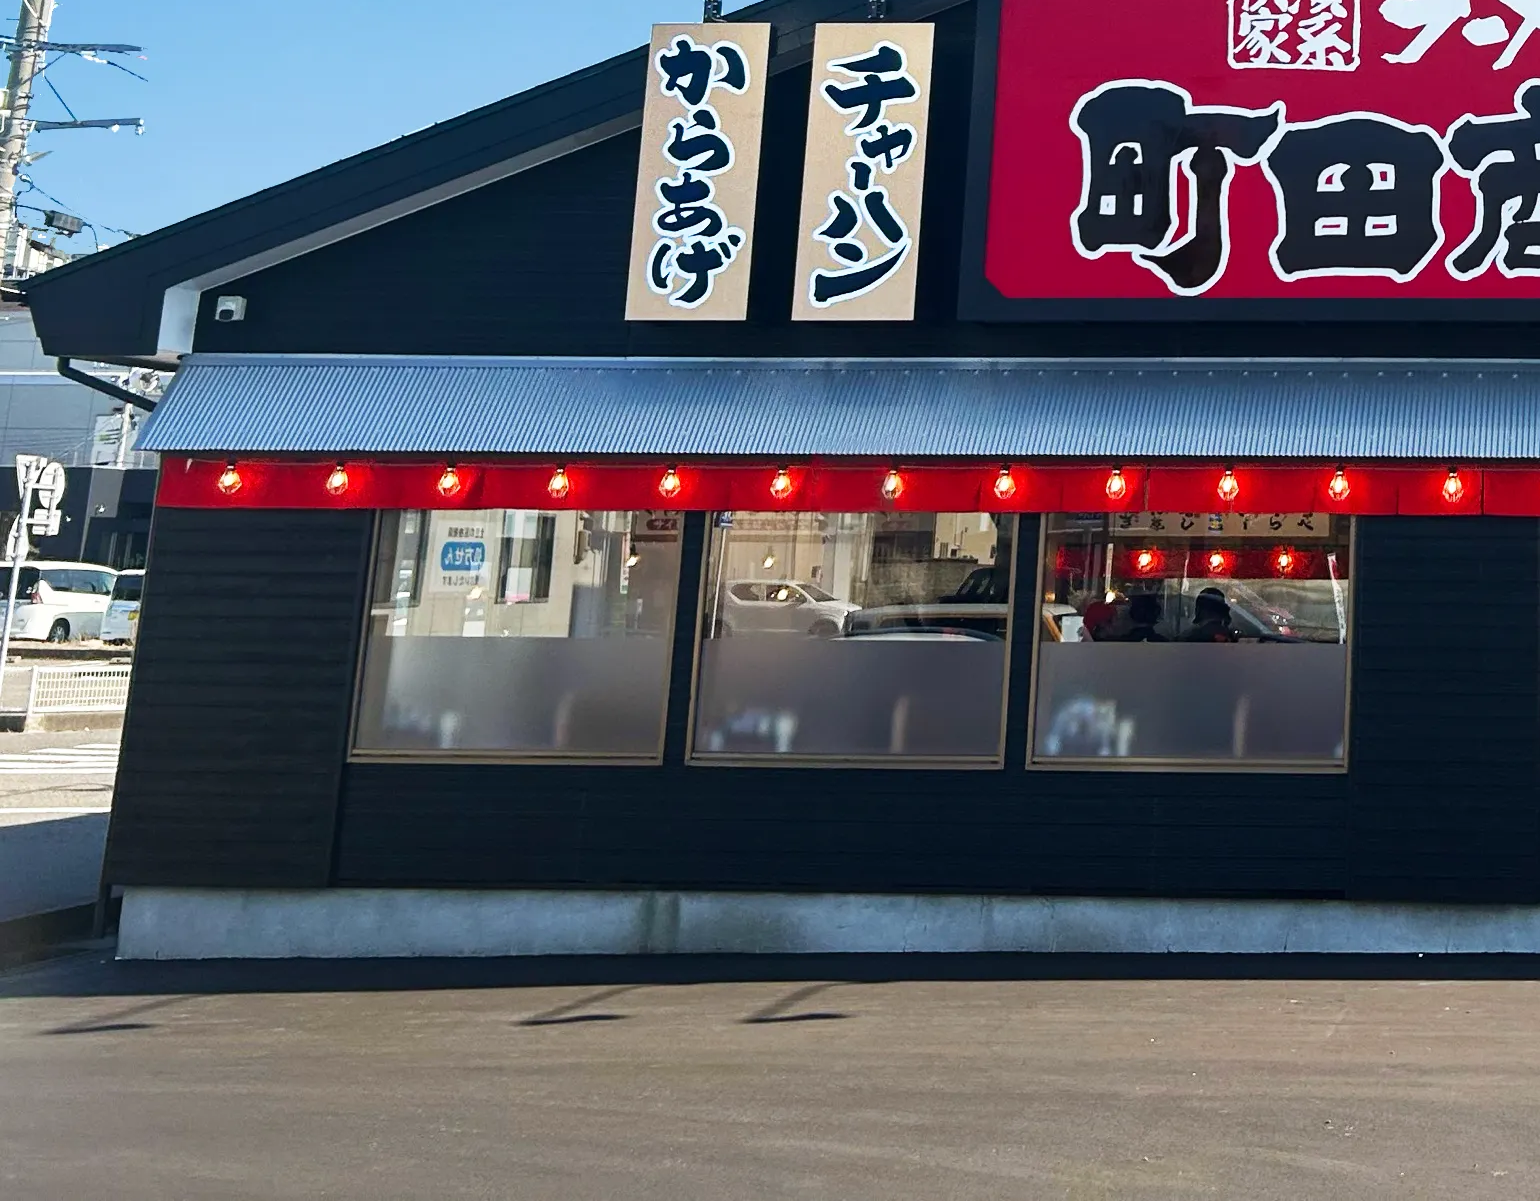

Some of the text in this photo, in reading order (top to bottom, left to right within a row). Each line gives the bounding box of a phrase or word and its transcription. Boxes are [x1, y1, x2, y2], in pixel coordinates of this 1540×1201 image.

[646, 34, 750, 309] からあげ
[808, 40, 922, 309] チャーハン
